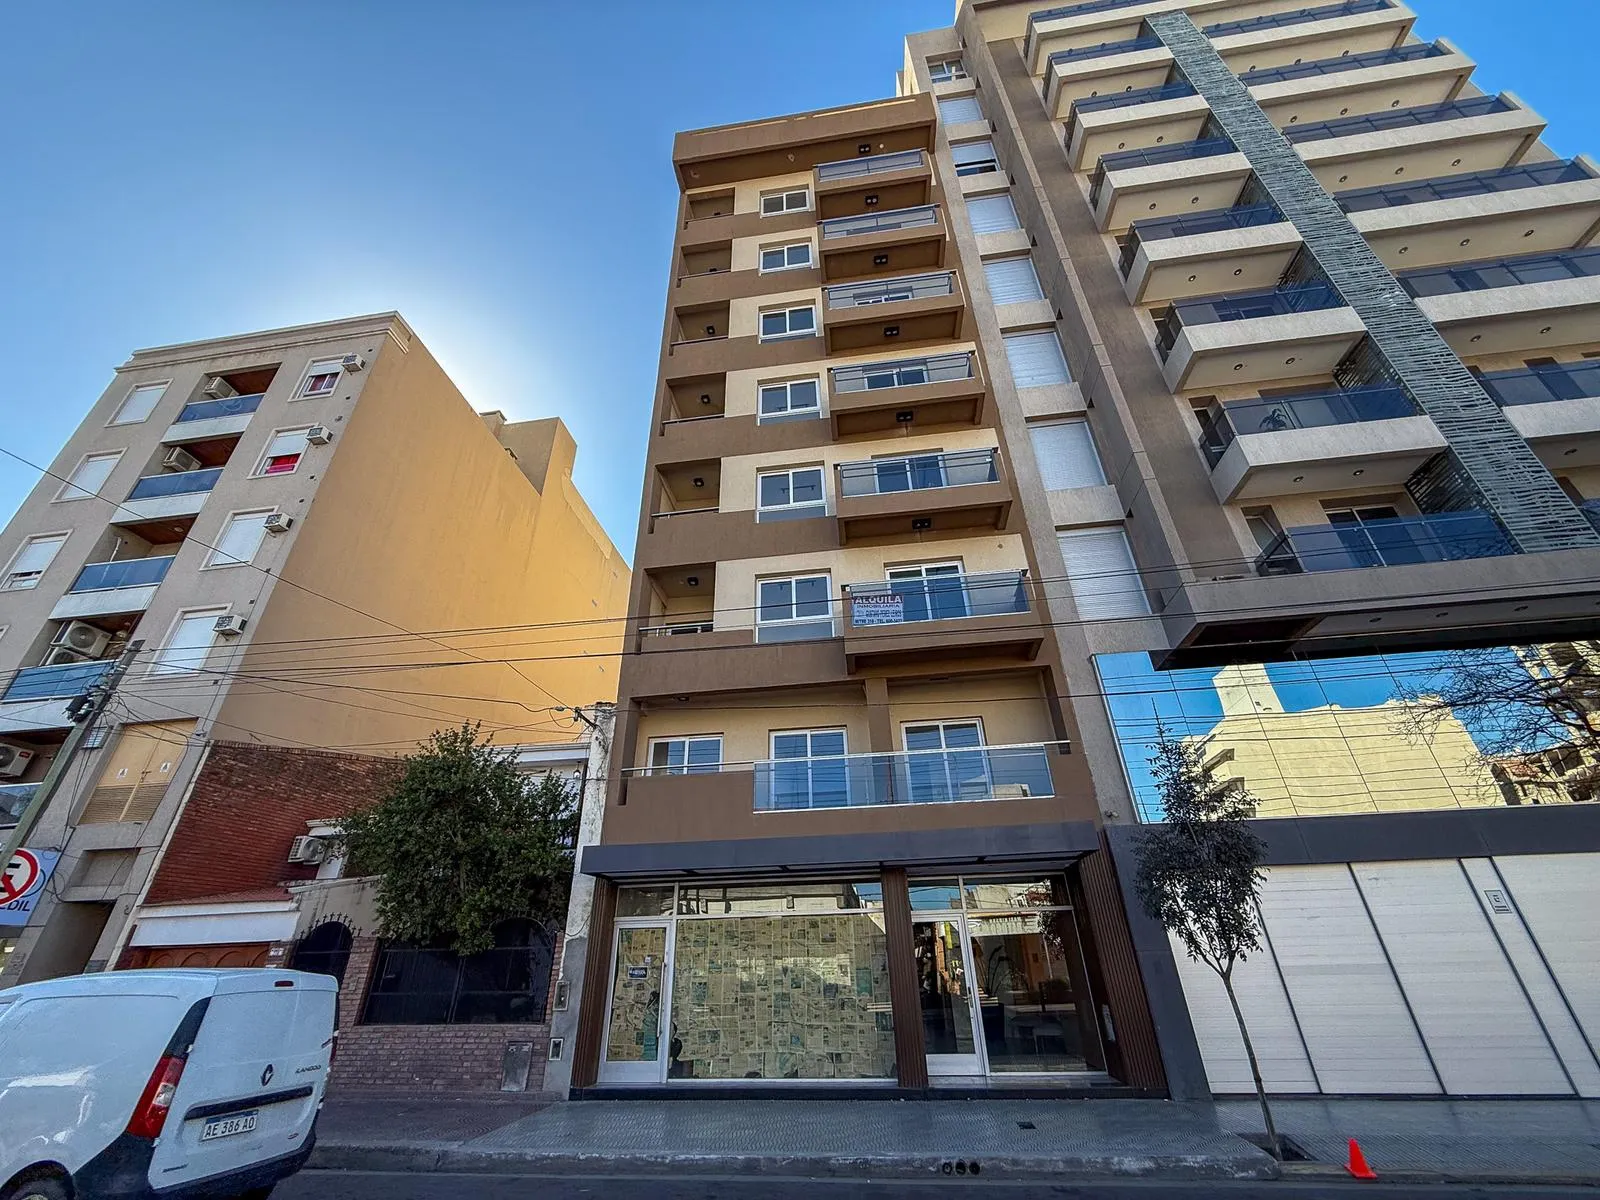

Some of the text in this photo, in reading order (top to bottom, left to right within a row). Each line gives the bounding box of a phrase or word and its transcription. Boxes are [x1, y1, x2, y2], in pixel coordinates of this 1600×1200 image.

[855, 595, 901, 603] ALQUILA
[0, 899, 30, 911] DIL
[204, 1123, 219, 1138] AE
[221, 1119, 240, 1134] 386
